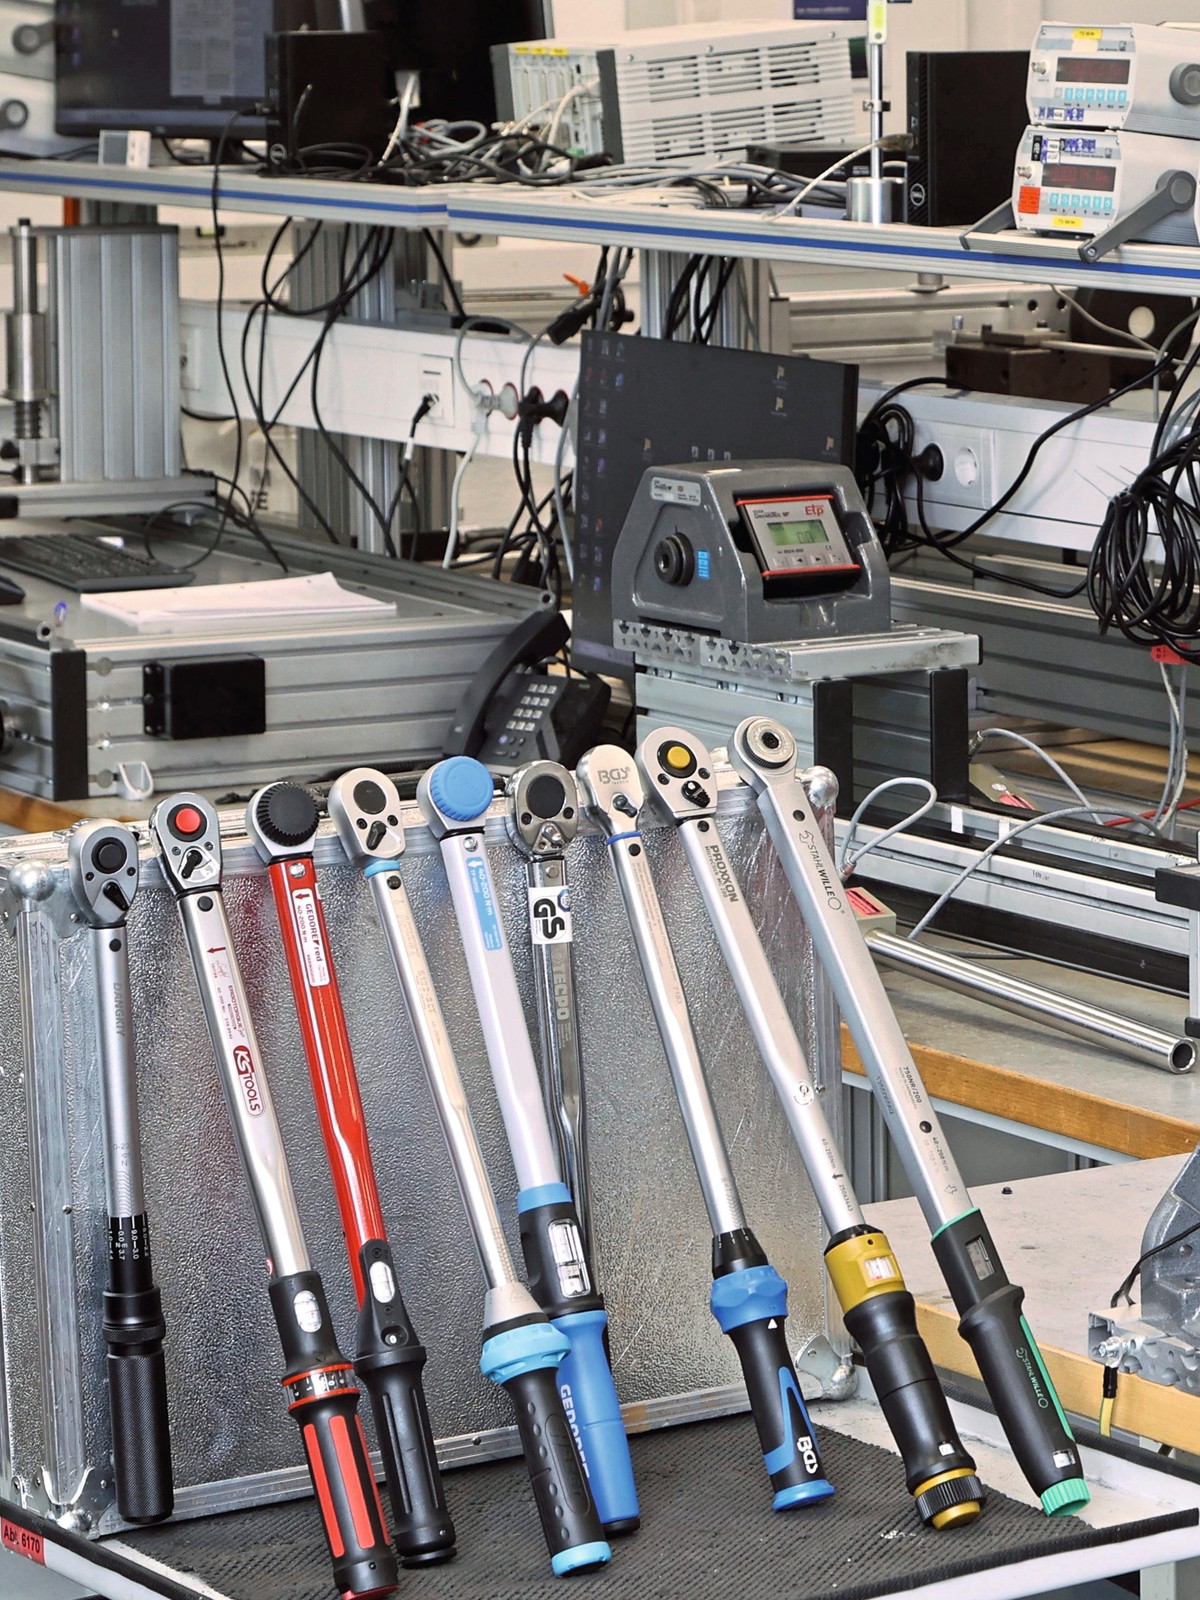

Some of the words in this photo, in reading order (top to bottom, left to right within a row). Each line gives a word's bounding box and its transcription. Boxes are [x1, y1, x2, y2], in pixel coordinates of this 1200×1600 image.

[479, 868, 490, 899] 40-200
[710, 845, 739, 902] PROXXON
[808, 844, 835, 897] STAHLWILLE
[306, 903, 319, 939] GEDORE
[314, 945, 323, 962] red
[533, 898, 565, 939] GS
[553, 963, 570, 1021] TECPO
[245, 1075, 260, 1112] TOOLS
[21, 1533, 40, 1554] 6170
